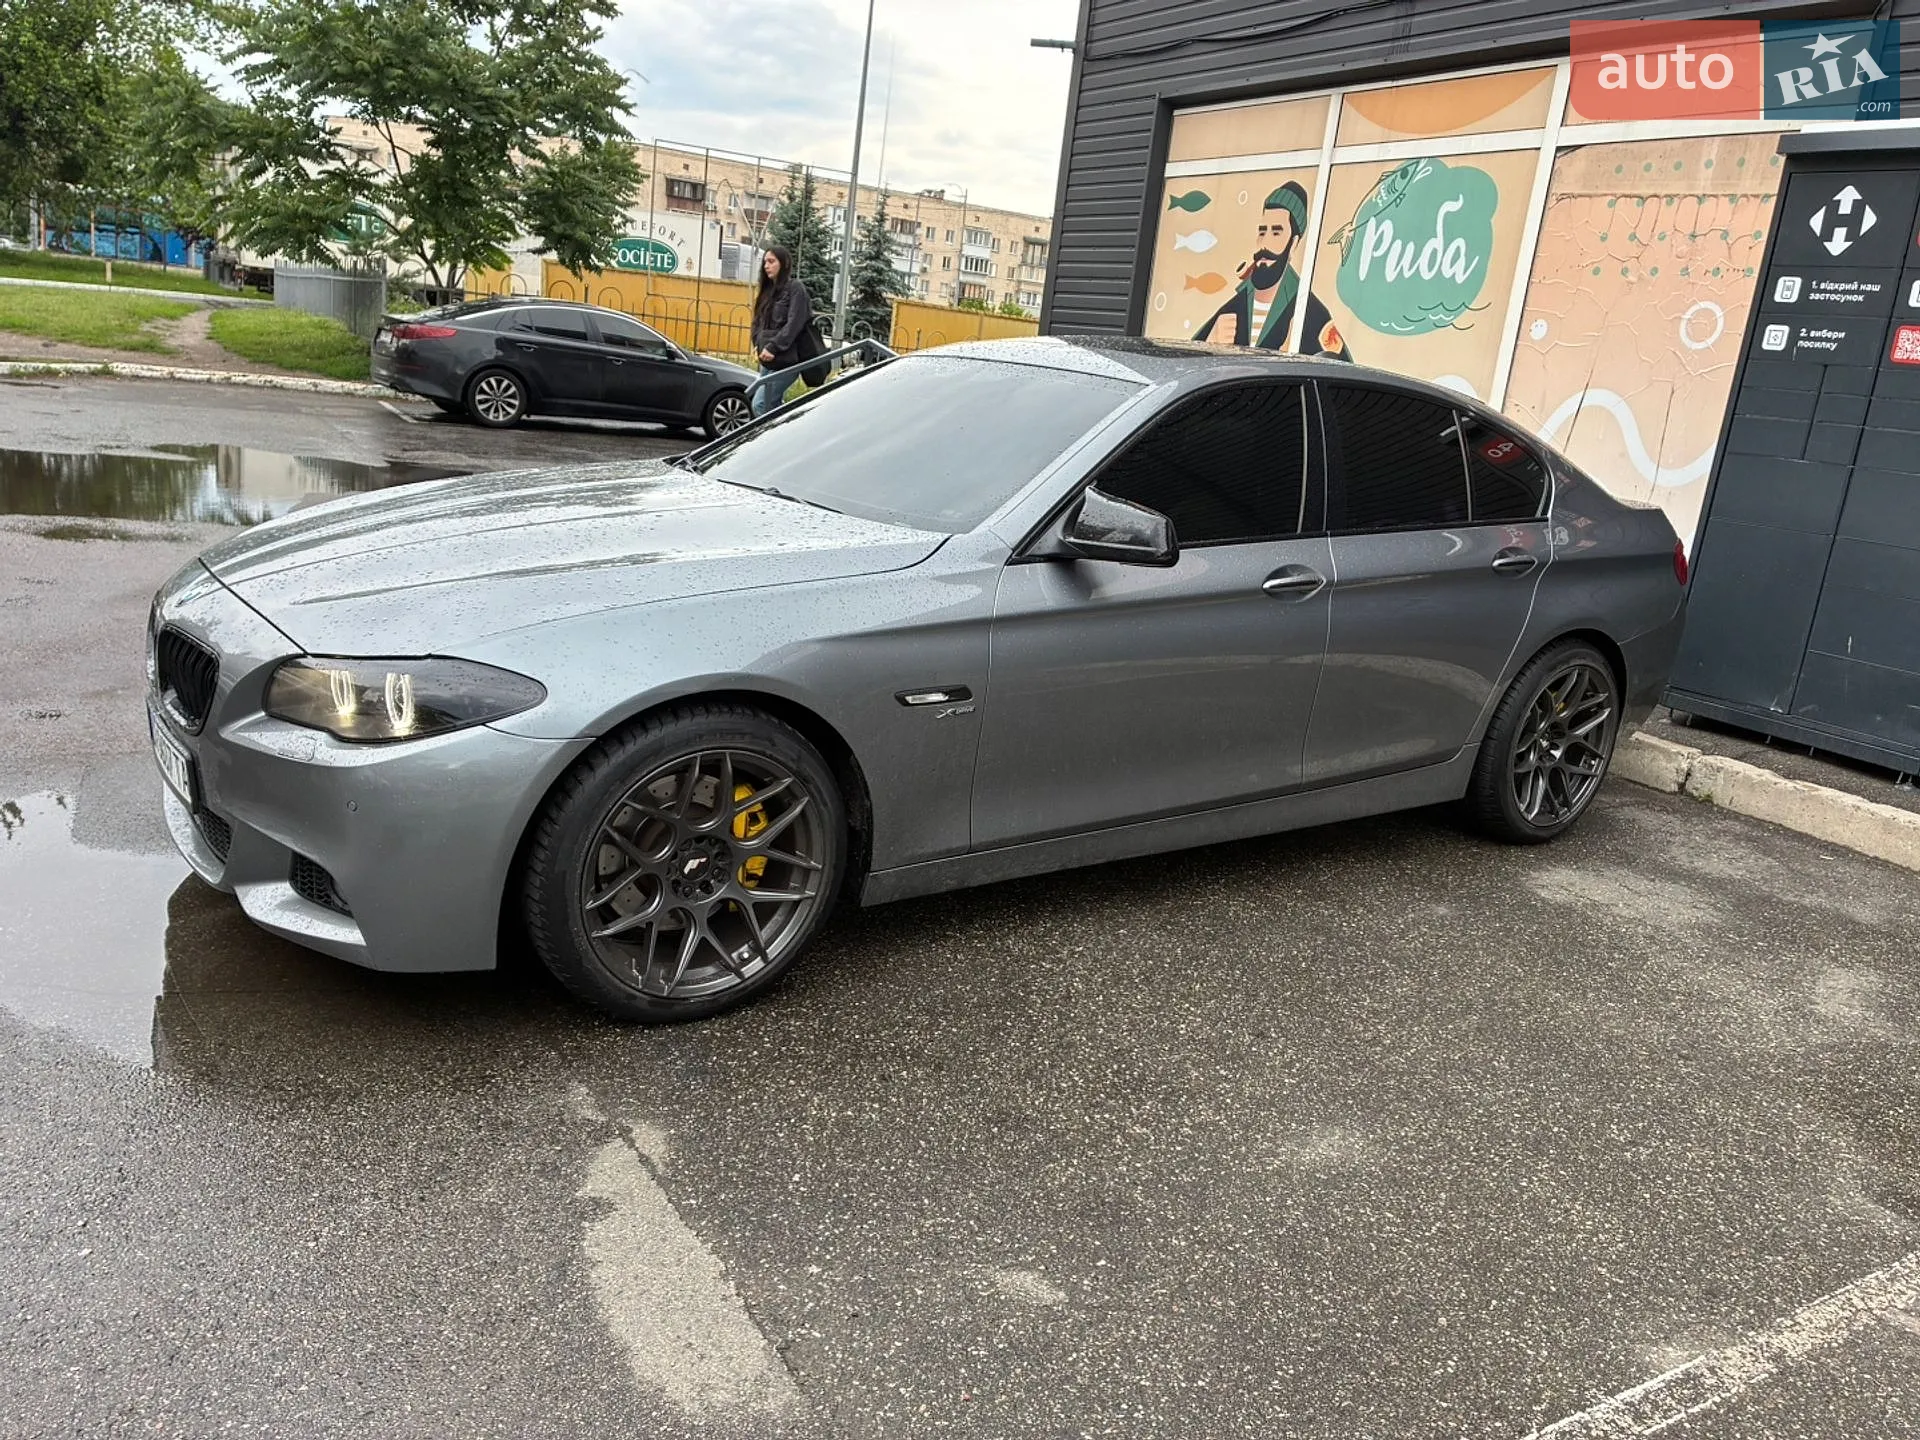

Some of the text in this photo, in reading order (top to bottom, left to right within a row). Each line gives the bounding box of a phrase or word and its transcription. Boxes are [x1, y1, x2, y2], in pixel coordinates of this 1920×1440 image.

[1359, 194, 1479, 284] Риба
[1811, 280, 1881, 292] 1. відкрий наш
[1808, 293, 1865, 302] застосунок
[1800, 328, 1846, 340] 2. вибери
[1797, 341, 1838, 351] посилку
